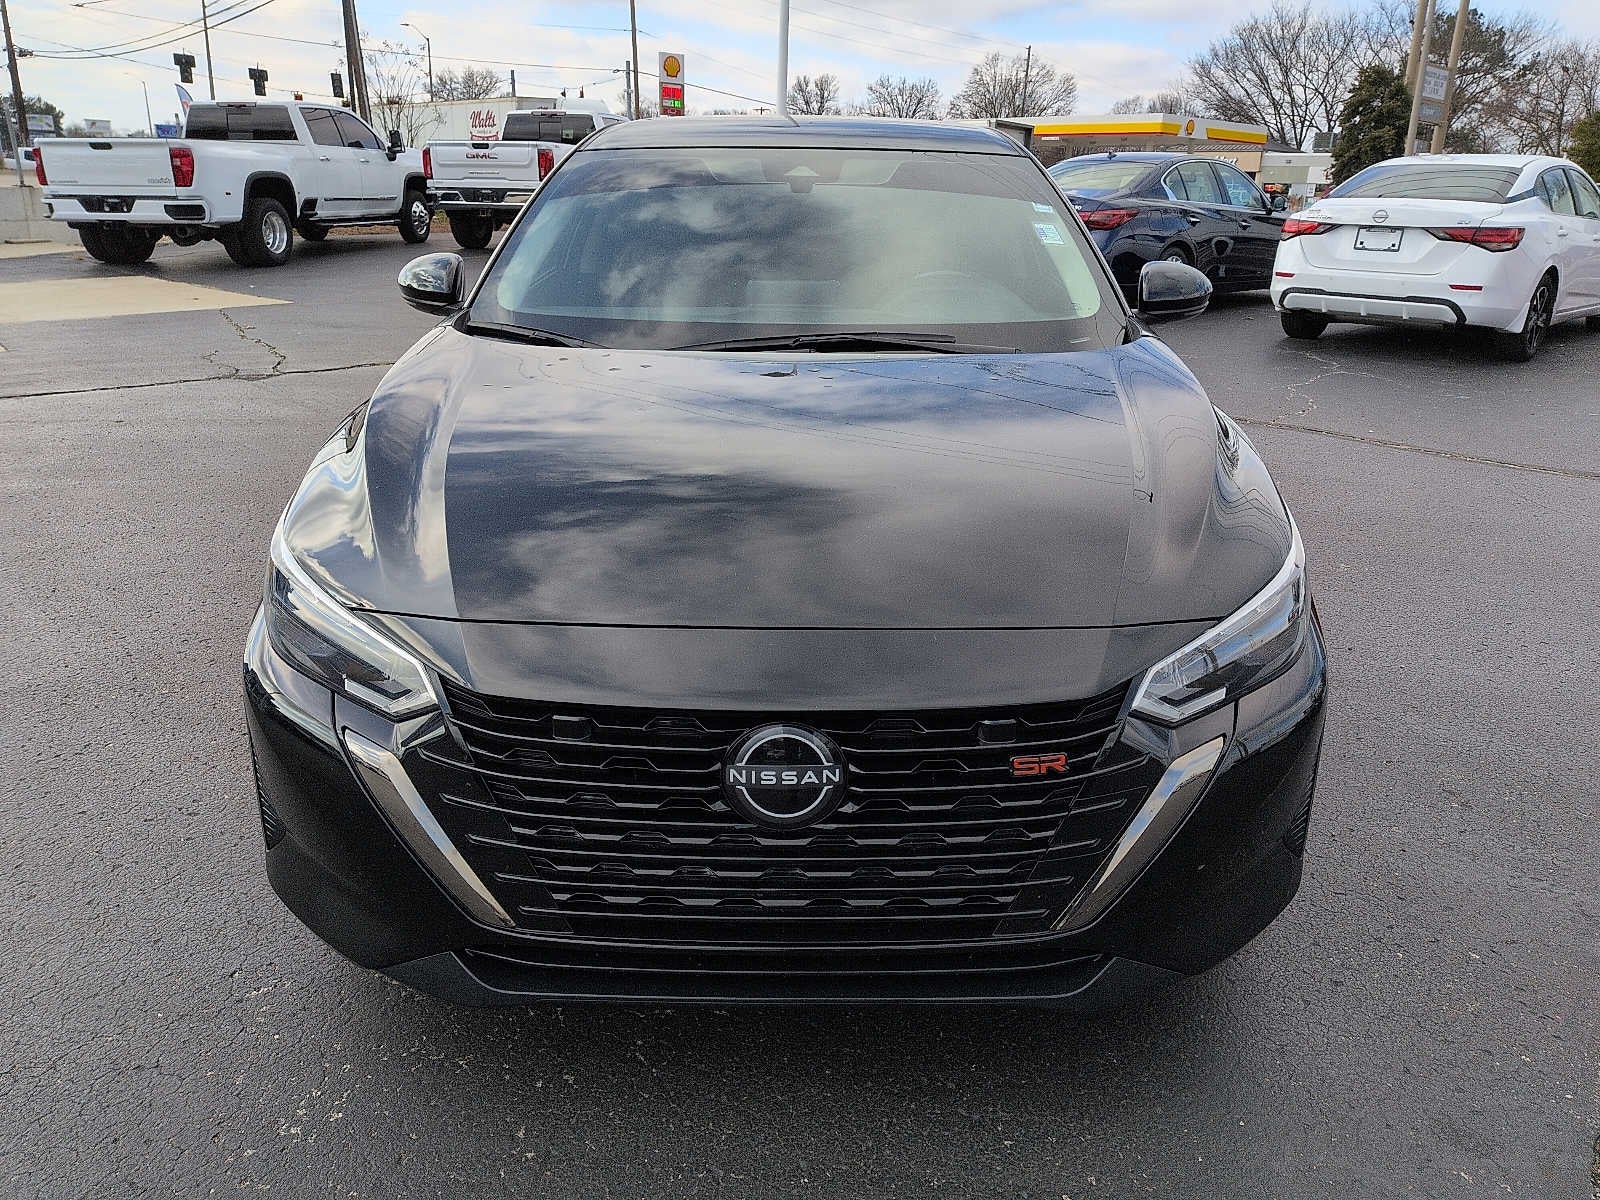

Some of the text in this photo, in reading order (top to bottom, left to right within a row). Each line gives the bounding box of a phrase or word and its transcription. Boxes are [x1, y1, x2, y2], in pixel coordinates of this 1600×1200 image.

[466, 152, 498, 160] GMC
[1011, 753, 1068, 776] SR
[729, 768, 840, 785] NISSAN
